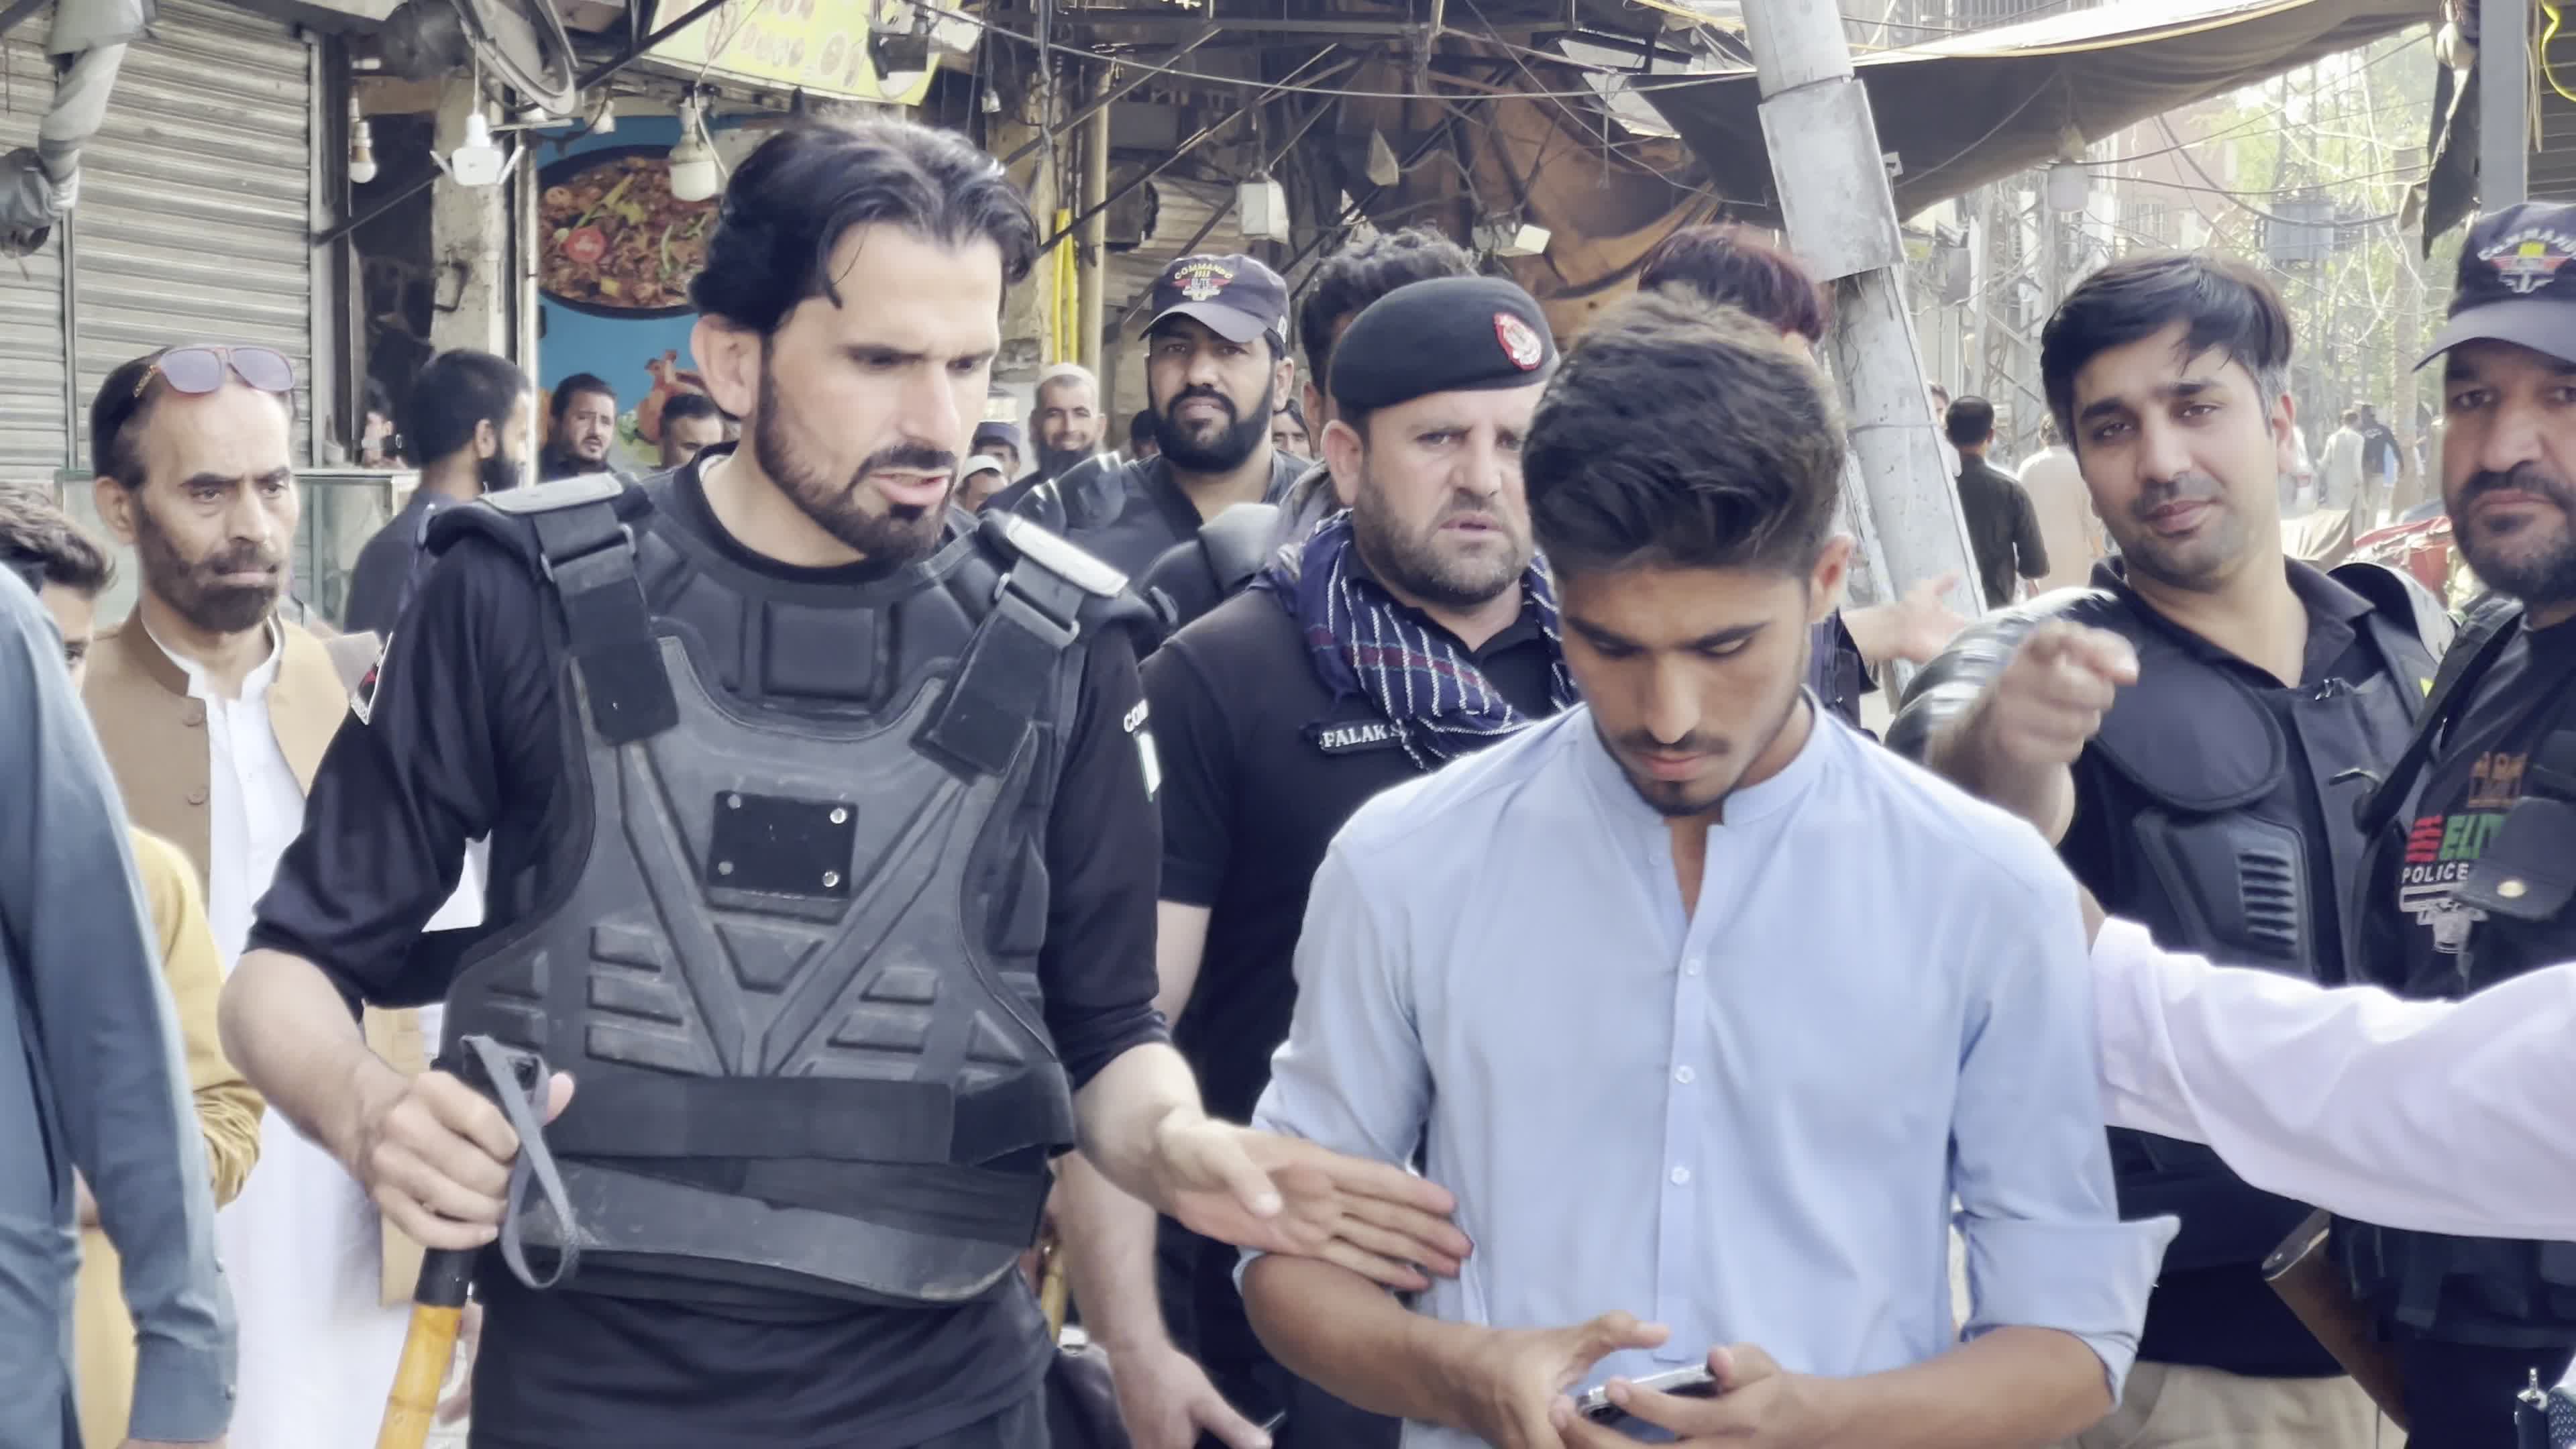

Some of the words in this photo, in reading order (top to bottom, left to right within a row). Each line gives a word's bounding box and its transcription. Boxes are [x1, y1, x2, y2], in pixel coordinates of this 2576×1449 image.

[1175, 264, 1233, 279] COMMANDO
[1321, 724, 1388, 748] PALAK
[2402, 862, 2469, 883] POLICE
